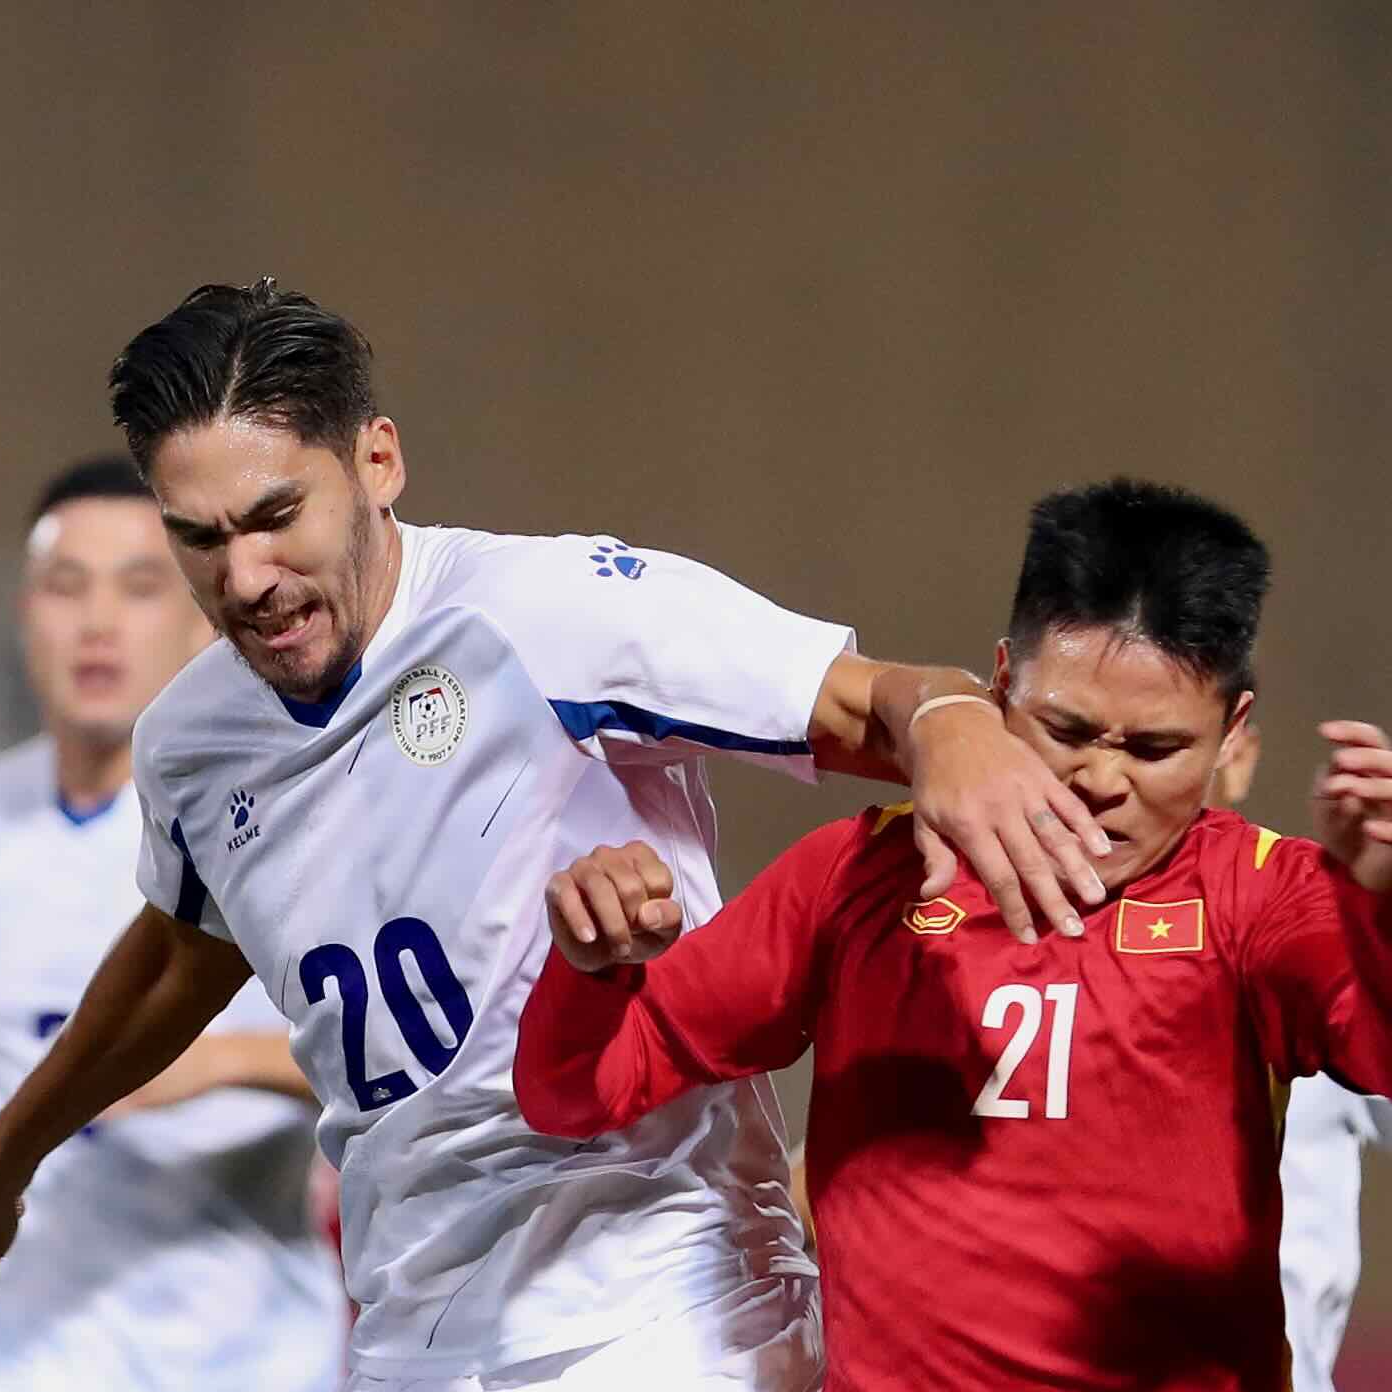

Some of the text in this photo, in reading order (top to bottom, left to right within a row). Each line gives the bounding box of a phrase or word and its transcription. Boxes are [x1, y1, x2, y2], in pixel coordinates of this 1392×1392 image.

[393, 668, 441, 695] FOOTBALL
[441, 673, 466, 743] FEDERATION
[226, 824, 261, 854] KELME
[299, 917, 474, 1113] 20
[970, 983, 1079, 1120] 21
